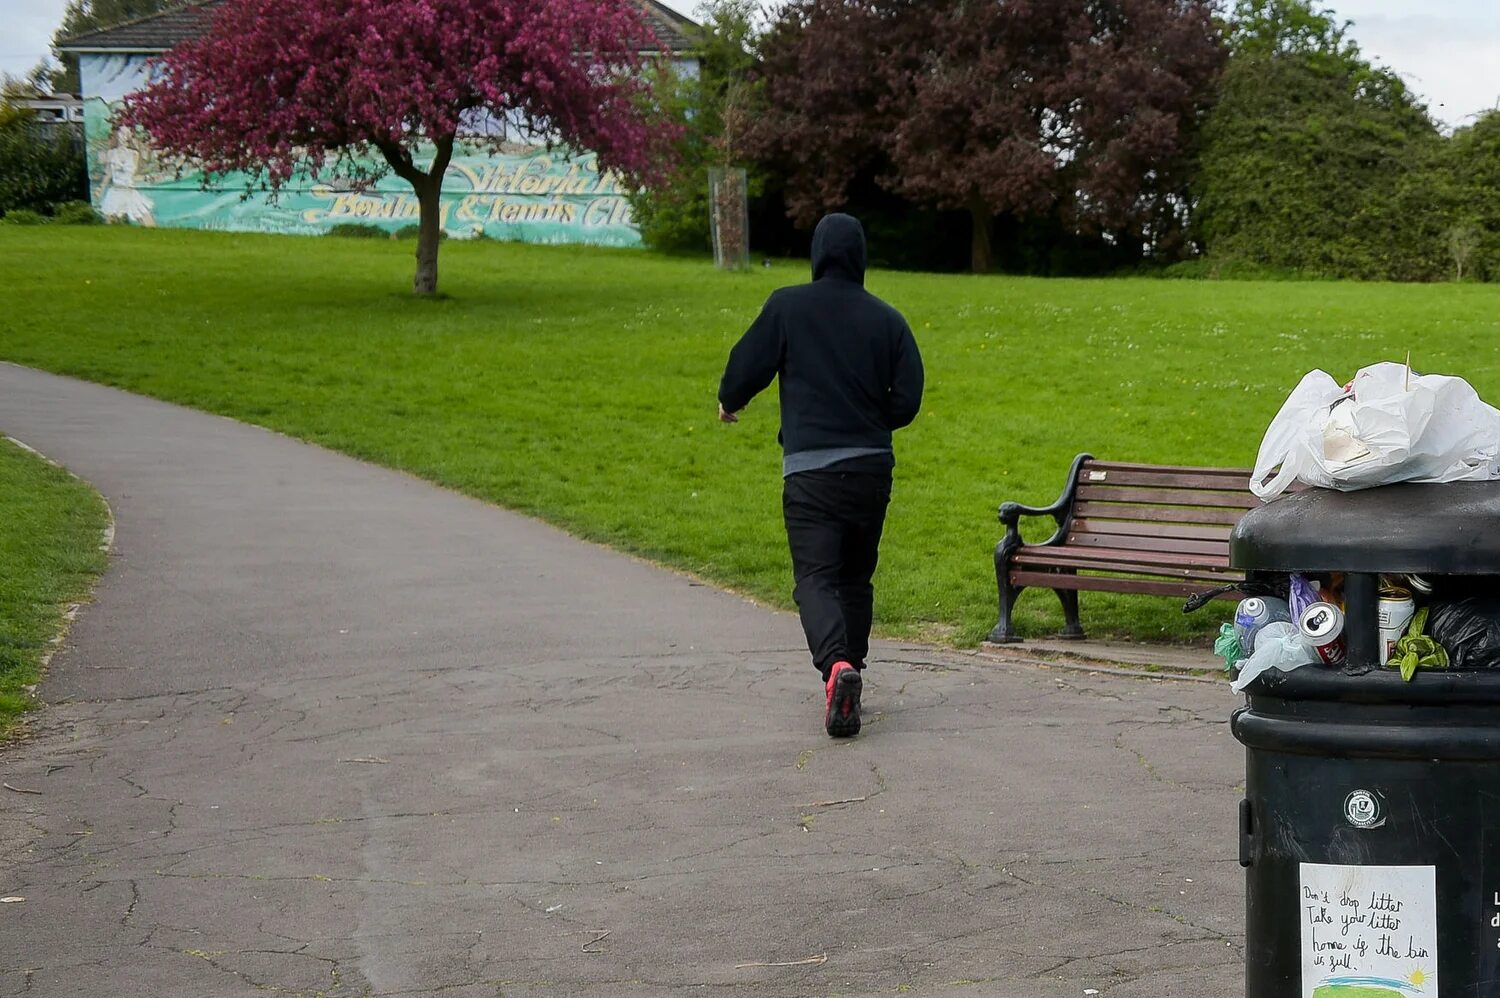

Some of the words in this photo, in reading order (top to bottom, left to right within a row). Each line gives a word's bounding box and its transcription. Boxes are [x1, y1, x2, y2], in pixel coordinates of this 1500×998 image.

[1304, 886, 1330, 903] Don't
[1340, 891, 1360, 916] drop
[1367, 892, 1403, 912] litter
[1307, 906, 1333, 924] Take
[1341, 914, 1366, 936] your
[1367, 912, 1401, 930] litter
[1313, 926, 1347, 952] home
[1376, 933, 1401, 958] the
[1404, 935, 1429, 959] bin
[1314, 953, 1325, 965] is
